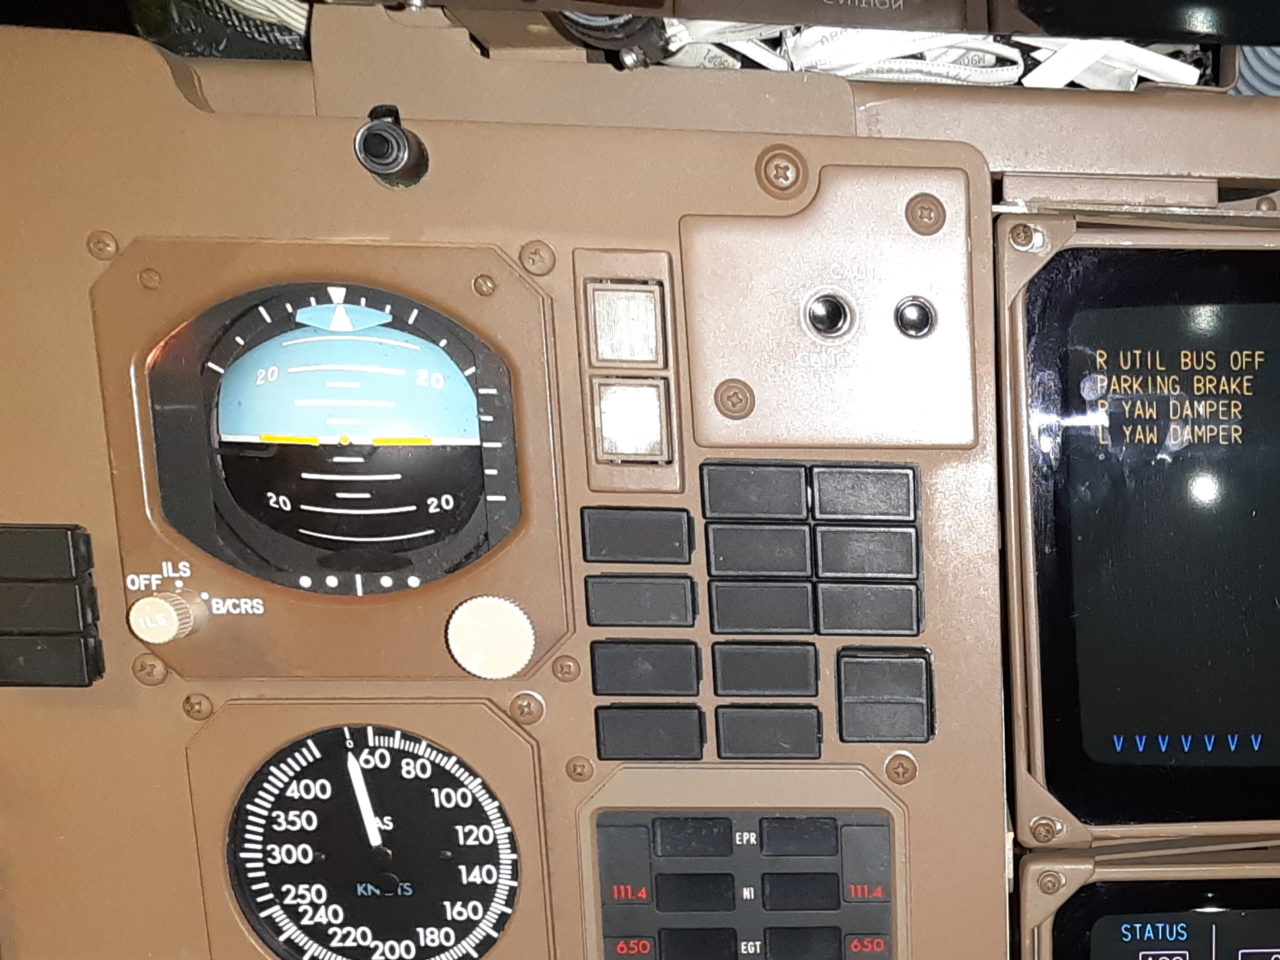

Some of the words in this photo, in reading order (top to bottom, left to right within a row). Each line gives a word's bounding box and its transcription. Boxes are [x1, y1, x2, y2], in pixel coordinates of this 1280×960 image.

[1096, 350, 1108, 370] R
[1119, 350, 1166, 371] UTIL
[1180, 350, 1216, 371] BUS
[1230, 351, 1265, 370] OFF
[1097, 375, 1181, 396] PARKING
[1193, 376, 1254, 396] BRAKE
[1122, 400, 1157, 420] YAW
[1169, 400, 1243, 420] DAMPER
[1122, 425, 1158, 445] YAW
[1170, 425, 1243, 445] DAMPER
[266, 491, 292, 512] 20
[426, 494, 455, 514] 20
[161, 561, 191, 578] ILS
[126, 574, 162, 591] OFF
[212, 597, 264, 615] B/CRS
[359, 748, 391, 769] 60
[401, 758, 432, 779] 80
[285, 779, 332, 800] 400
[430, 787, 473, 809] 100
[454, 825, 494, 845] 120
[735, 832, 757, 845] EPR
[266, 844, 313, 865] 300
[1121, 923, 1188, 942] STATUS
[370, 940, 416, 960] 200
[616, 940, 650, 954] 650
[741, 942, 761, 953] EGT
[850, 938, 885, 952] 650
